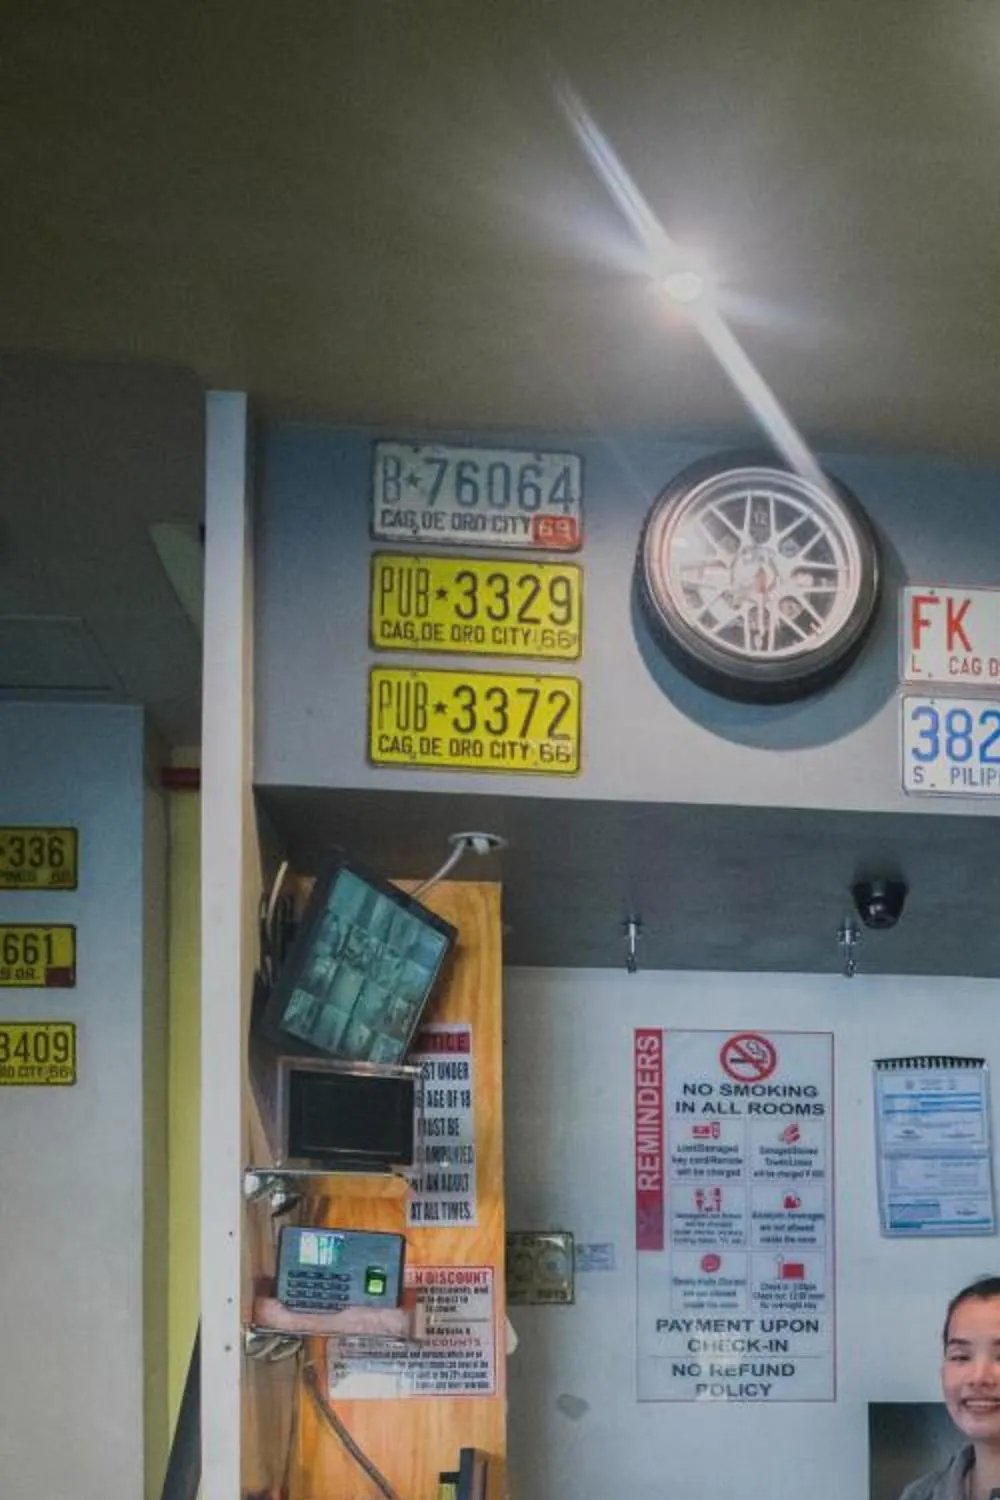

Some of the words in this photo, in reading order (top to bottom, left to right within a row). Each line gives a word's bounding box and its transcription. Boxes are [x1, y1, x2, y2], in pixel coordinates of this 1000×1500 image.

[382, 455, 400, 504] B
[424, 457, 575, 513] 76064
[422, 511, 445, 530] DE
[451, 512, 486, 532] ORO
[491, 514, 531, 534] CITY
[380, 567, 430, 617] PUB
[453, 569, 573, 626] 3329
[911, 596, 973, 652] FK
[421, 623, 445, 640] DE
[451, 624, 486, 643] ORO
[491, 626, 531, 646] CITY
[540, 628, 571, 649] 66
[911, 654, 921, 673] L
[949, 656, 983, 676] CAG
[378, 680, 428, 732] PUB
[452, 685, 572, 741] 3372
[419, 737, 443, 756] DE
[449, 738, 483, 759] ORO
[490, 740, 530, 761] CITY
[539, 743, 571, 763] 66
[913, 766, 925, 784] S
[8, 835, 65, 869] 336
[682, 1083, 713, 1098] NO
[720, 1083, 819, 1099] SMOKING
[637, 1035, 662, 1191] REMINDERS
[675, 1101, 696, 1114] IN
[701, 1102, 742, 1115] ALL
[747, 1102, 826, 1116] ROOMS
[655, 1318, 755, 1334] PAYMENT
[760, 1319, 820, 1334] UPON
[687, 1339, 789, 1353] CHECK-IN
[671, 1363, 702, 1377] NO
[709, 1363, 796, 1378] REFUND
[695, 1383, 773, 1398] POLICY
